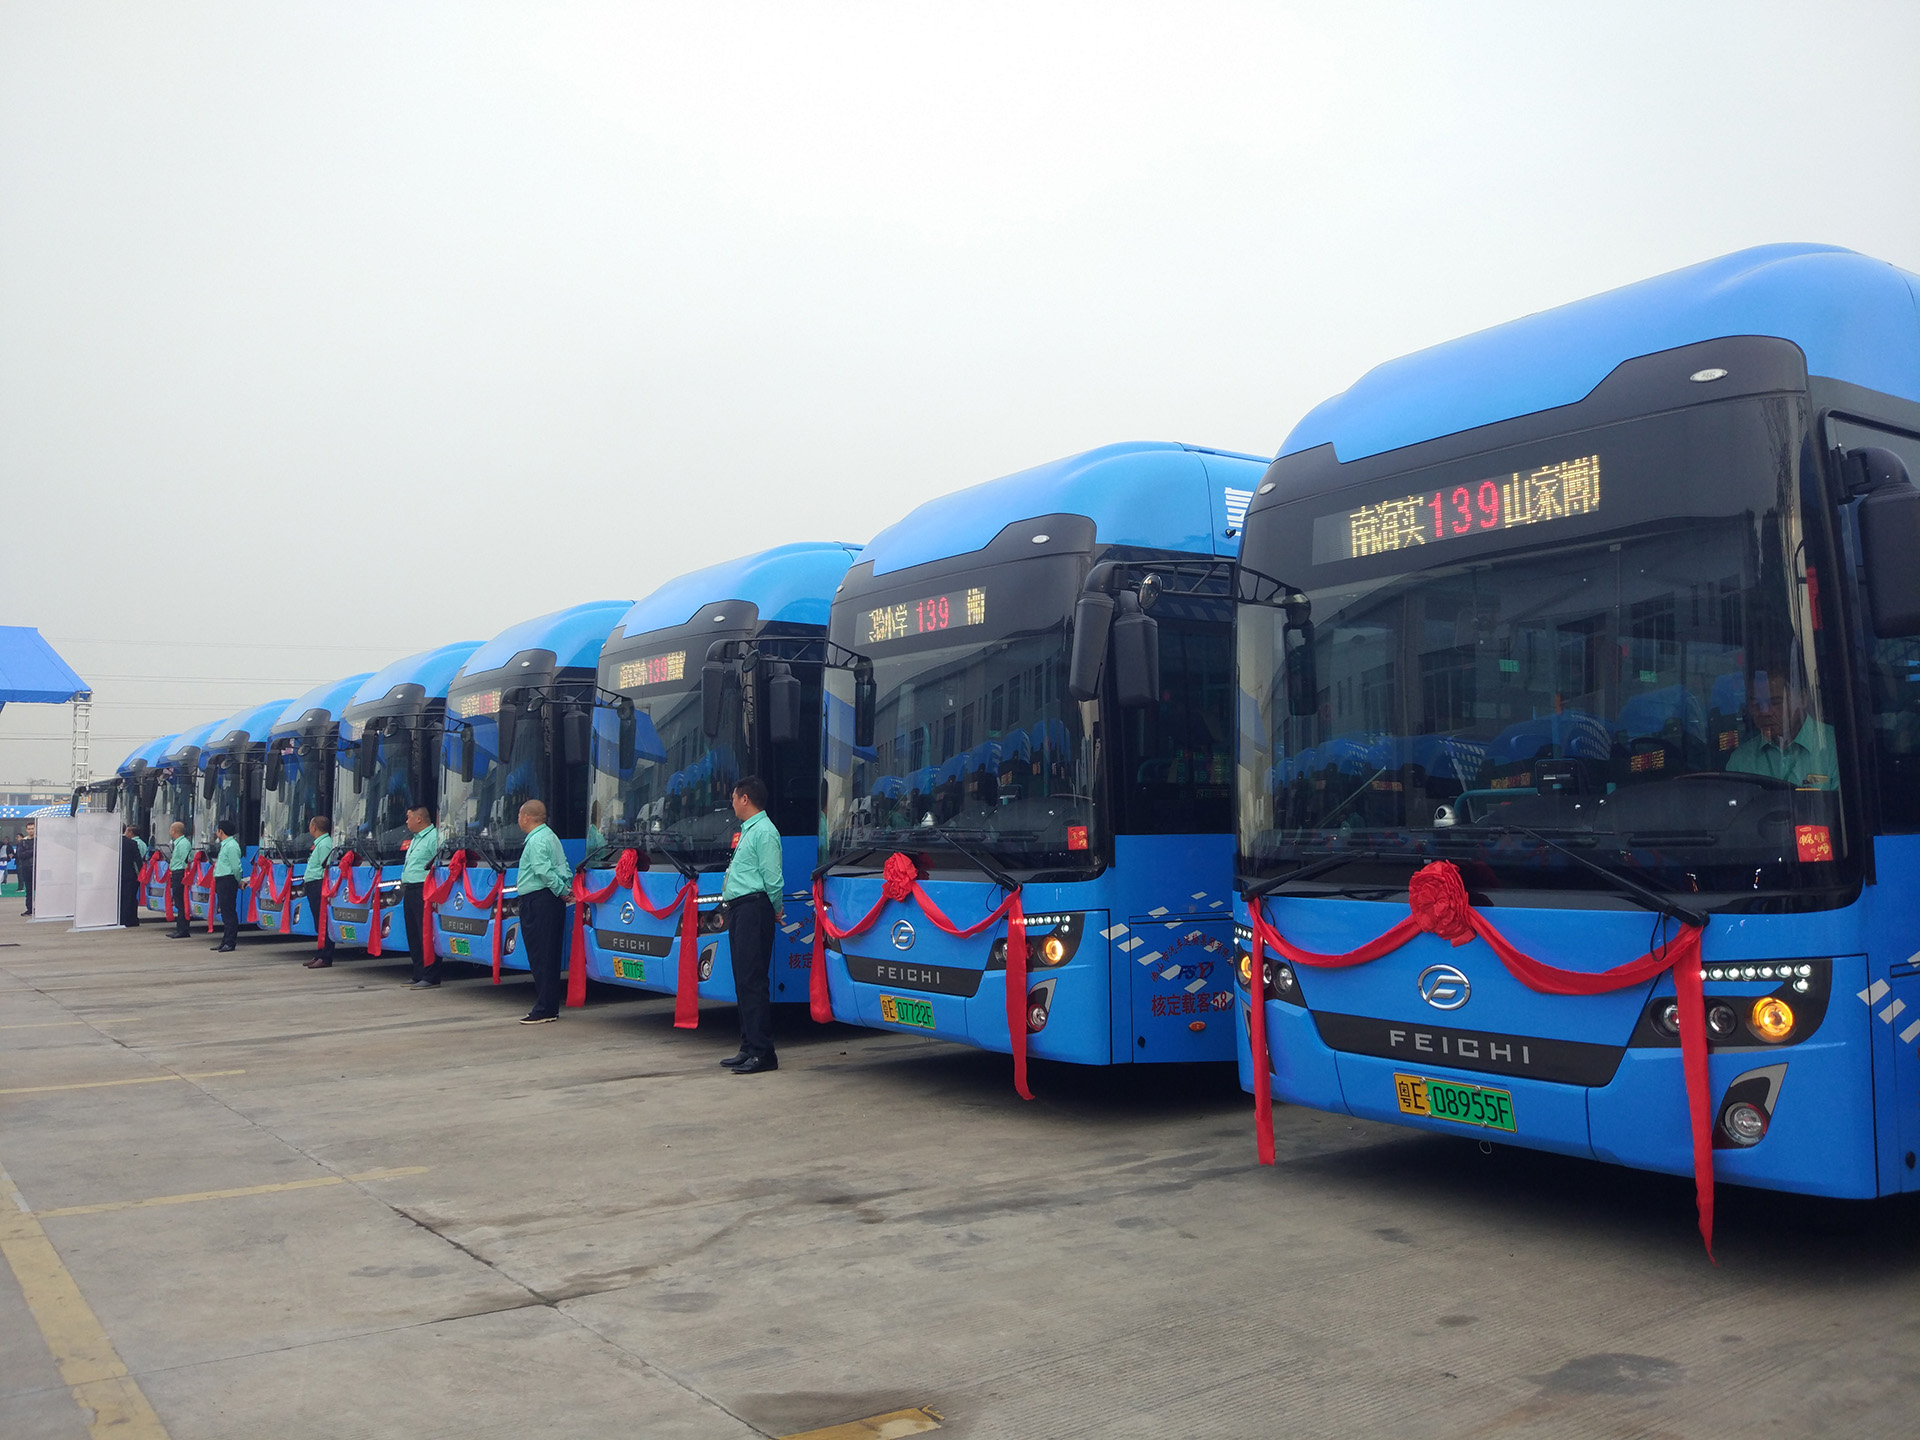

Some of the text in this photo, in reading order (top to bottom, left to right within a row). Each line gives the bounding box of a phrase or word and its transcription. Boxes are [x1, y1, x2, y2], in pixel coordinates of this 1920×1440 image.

[1428, 481, 1499, 538] 139
[915, 597, 949, 633] 139
[648, 656, 667, 684] 139
[612, 937, 650, 951] FEICHI
[877, 965, 940, 984] FEICHI
[1389, 1029, 1530, 1065] FEICHI
